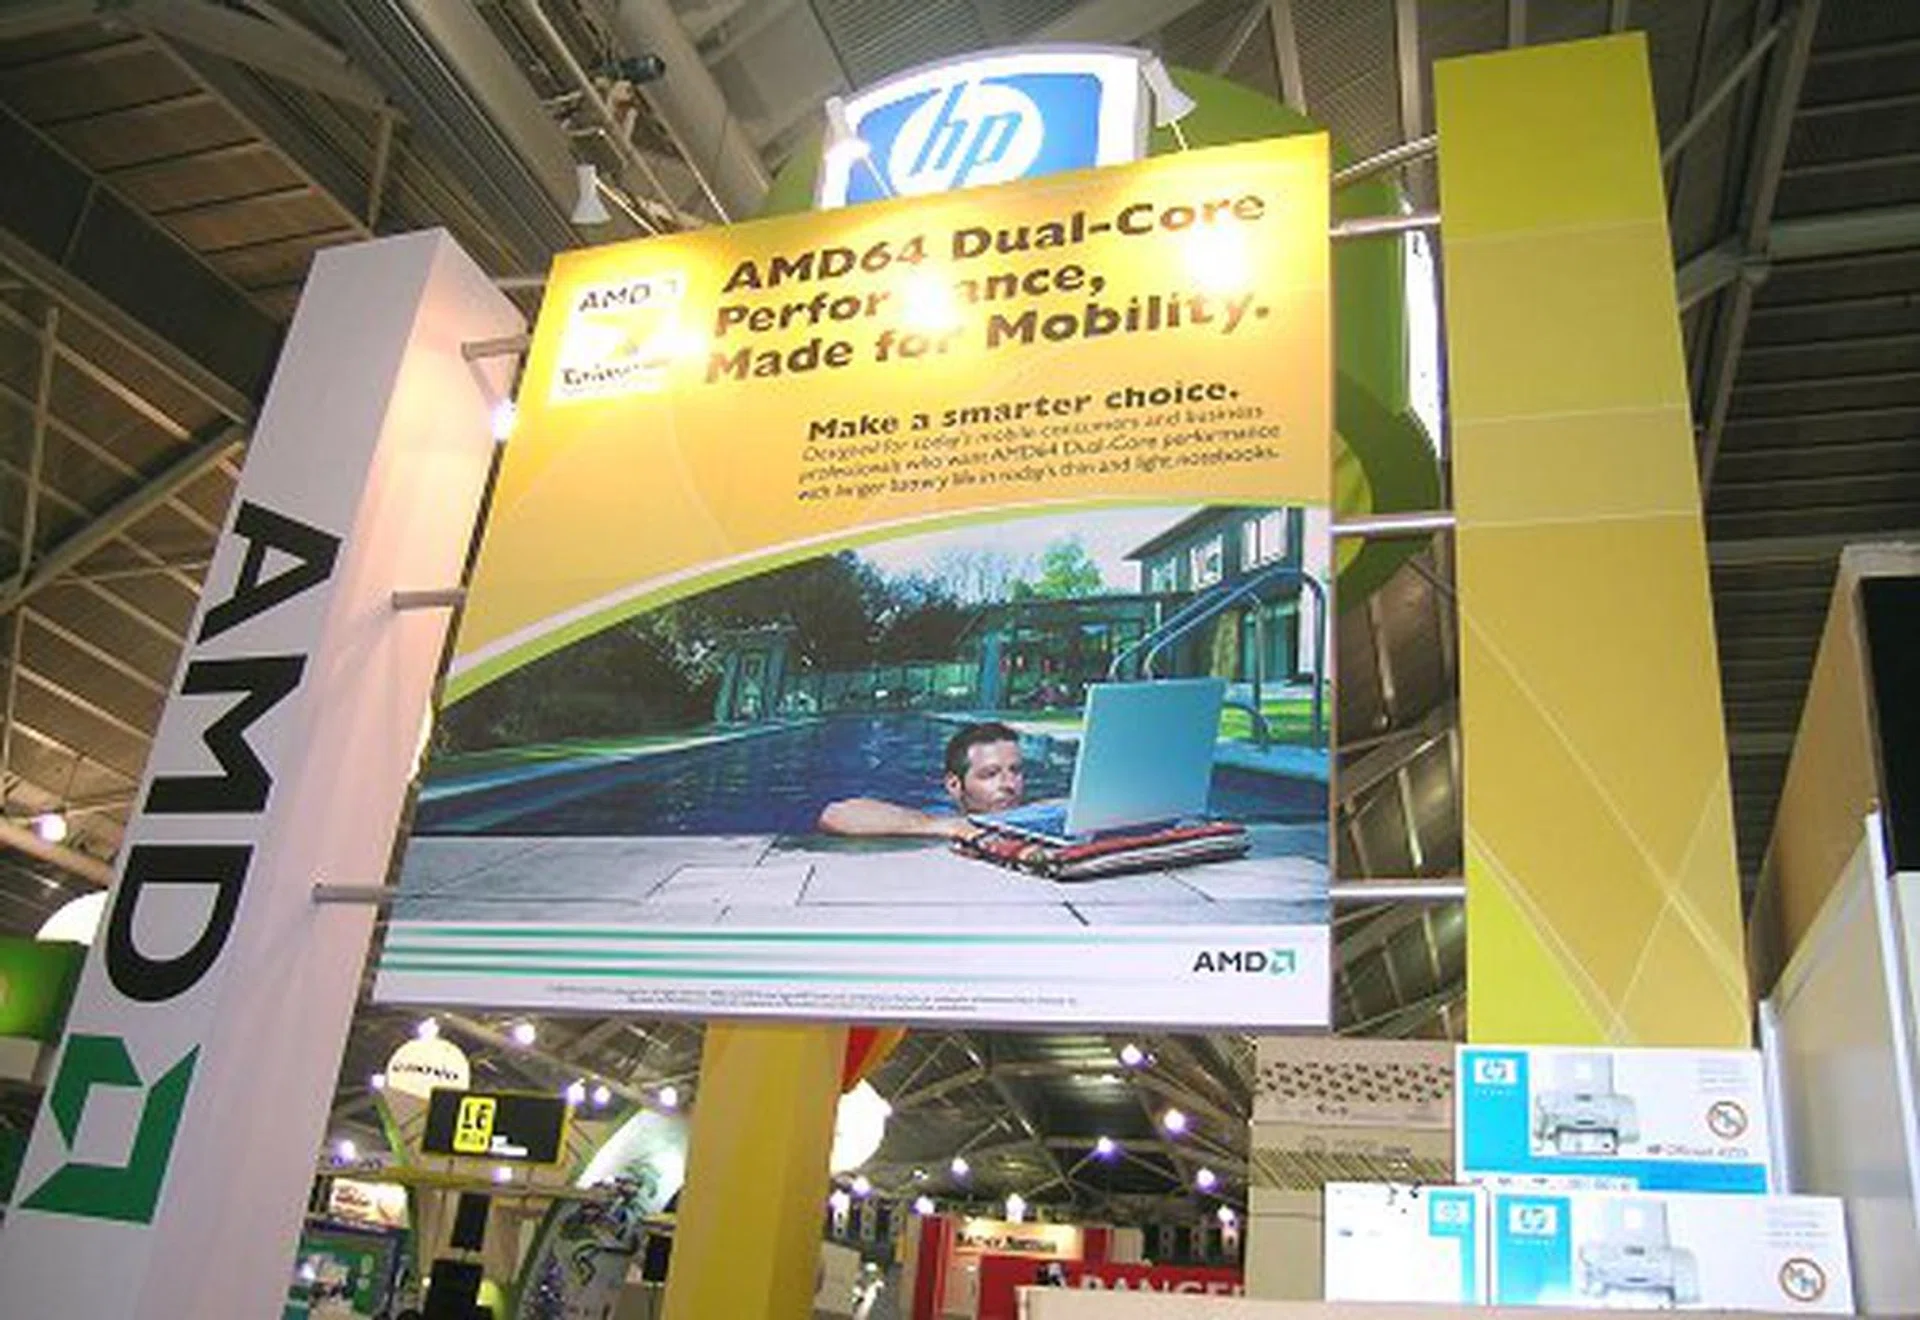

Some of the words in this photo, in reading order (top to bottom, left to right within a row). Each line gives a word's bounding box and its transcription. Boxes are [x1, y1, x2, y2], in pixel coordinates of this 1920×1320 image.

[909, 81, 1022, 189] hp
[722, 236, 926, 293] AMD64
[953, 196, 1265, 260] Dual-Core
[705, 338, 853, 384] Made
[986, 293, 1269, 349] Mobility.
[715, 265, 1106, 337] Perforance,
[808, 415, 899, 442] Make
[911, 413, 930, 431] a
[942, 395, 1091, 427] smarter
[1105, 380, 1239, 410] choice.
[105, 499, 343, 1002] AMD
[1193, 950, 1268, 973] AMD
